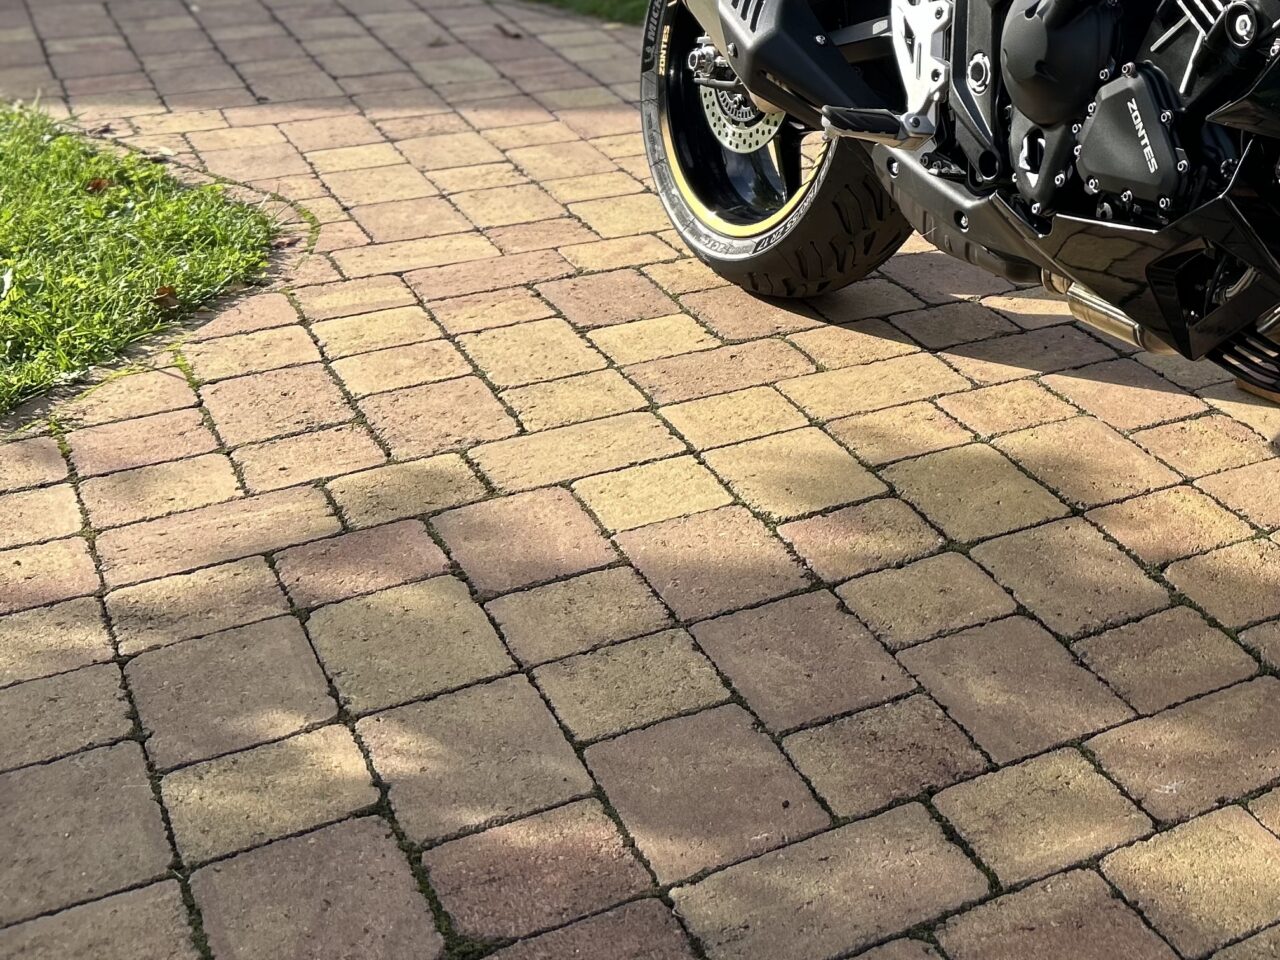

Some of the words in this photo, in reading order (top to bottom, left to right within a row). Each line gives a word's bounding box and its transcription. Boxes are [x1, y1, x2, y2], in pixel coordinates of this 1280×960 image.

[659, 24, 670, 77] ZONTES
[1127, 97, 1159, 174] ZONTES
[756, 237, 770, 252] 17
